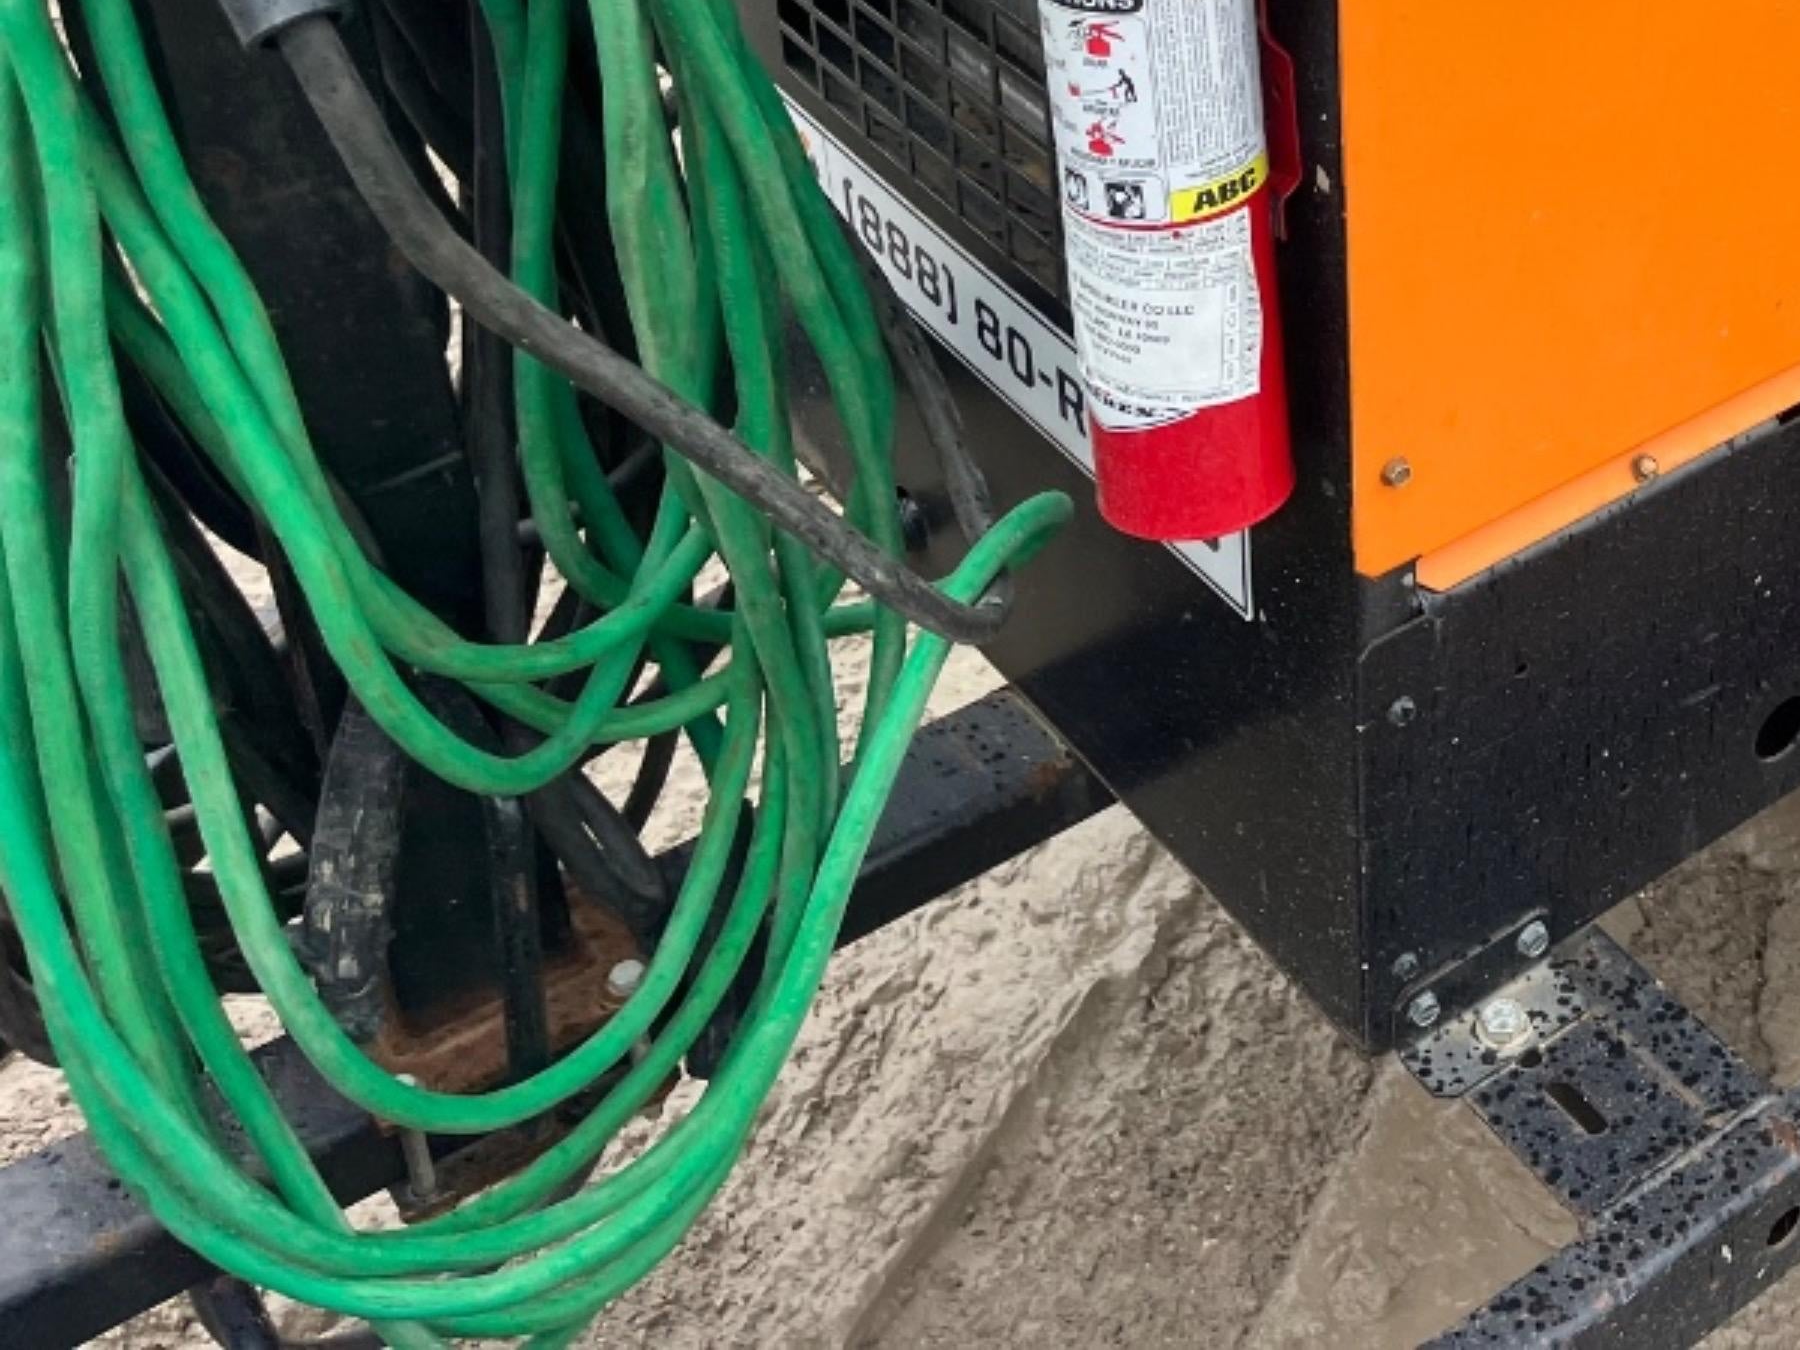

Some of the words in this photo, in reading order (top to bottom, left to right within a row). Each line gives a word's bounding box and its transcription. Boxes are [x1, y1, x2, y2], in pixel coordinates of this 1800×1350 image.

[1193, 167, 1257, 214] ABC
[842, 177, 958, 325] (888)
[974, 297, 1087, 438] 80-R
